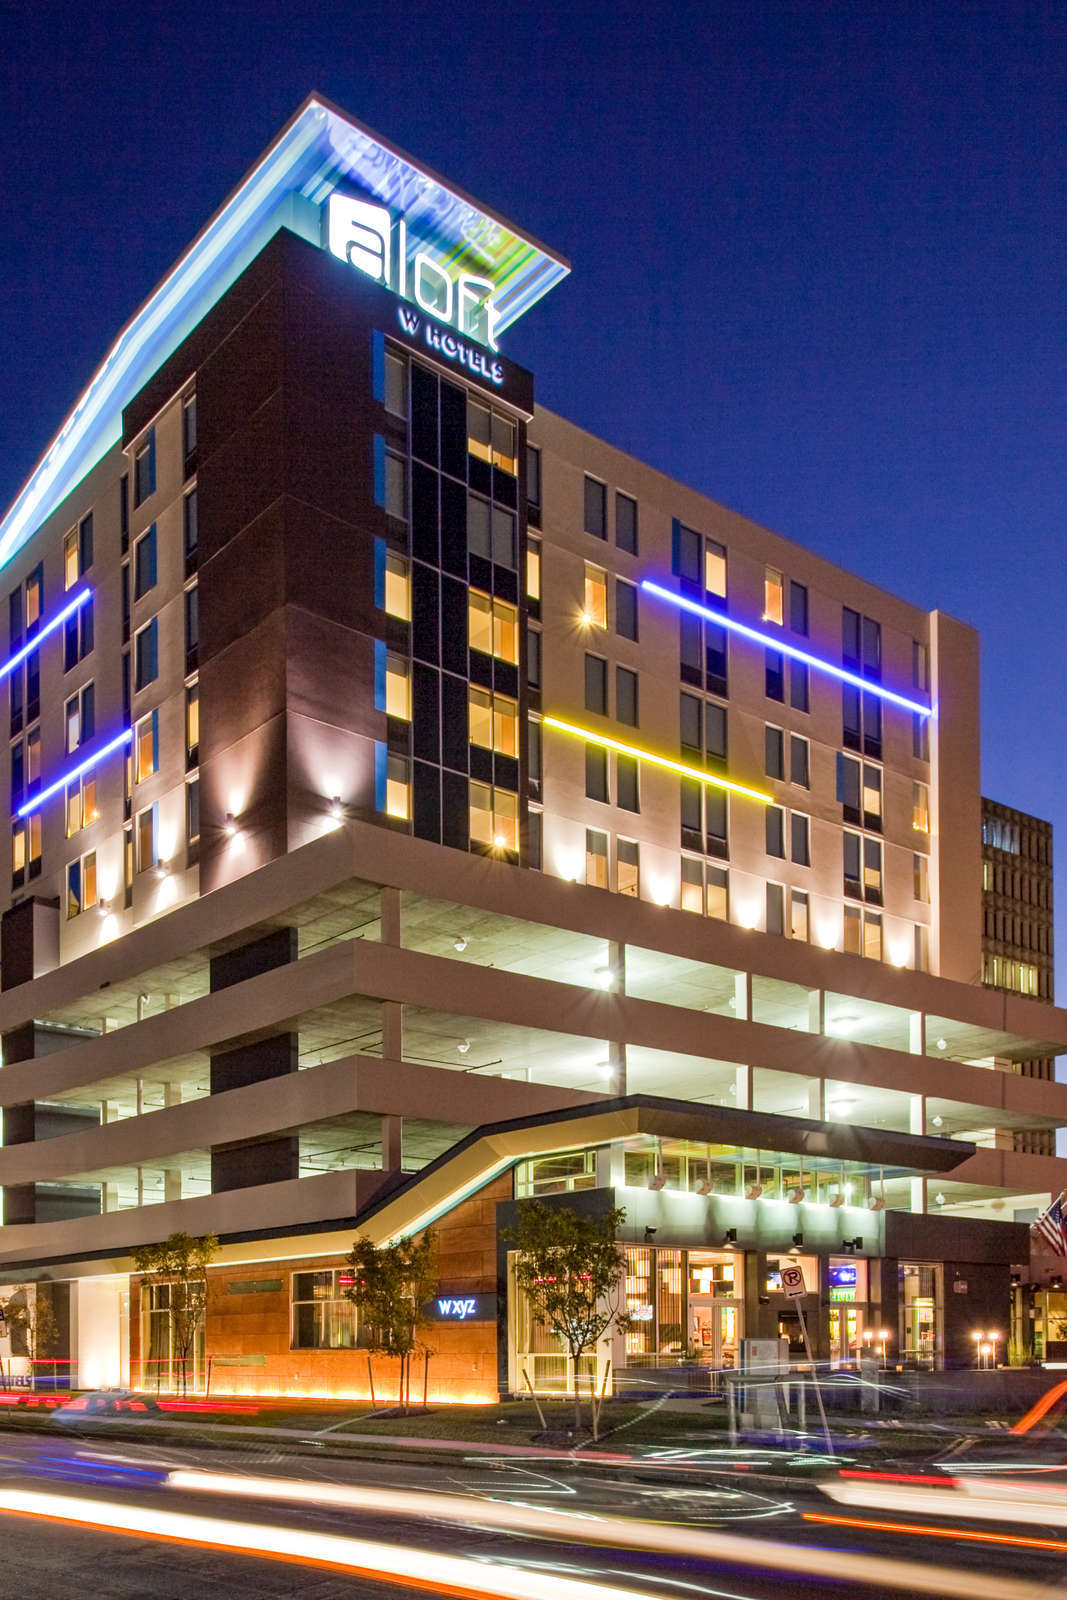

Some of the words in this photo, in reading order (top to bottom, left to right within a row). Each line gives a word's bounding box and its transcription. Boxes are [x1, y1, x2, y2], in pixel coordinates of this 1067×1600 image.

[398, 306, 420, 336] W
[425, 324, 504, 384] HOTELS
[787, 1271, 798, 1283] P
